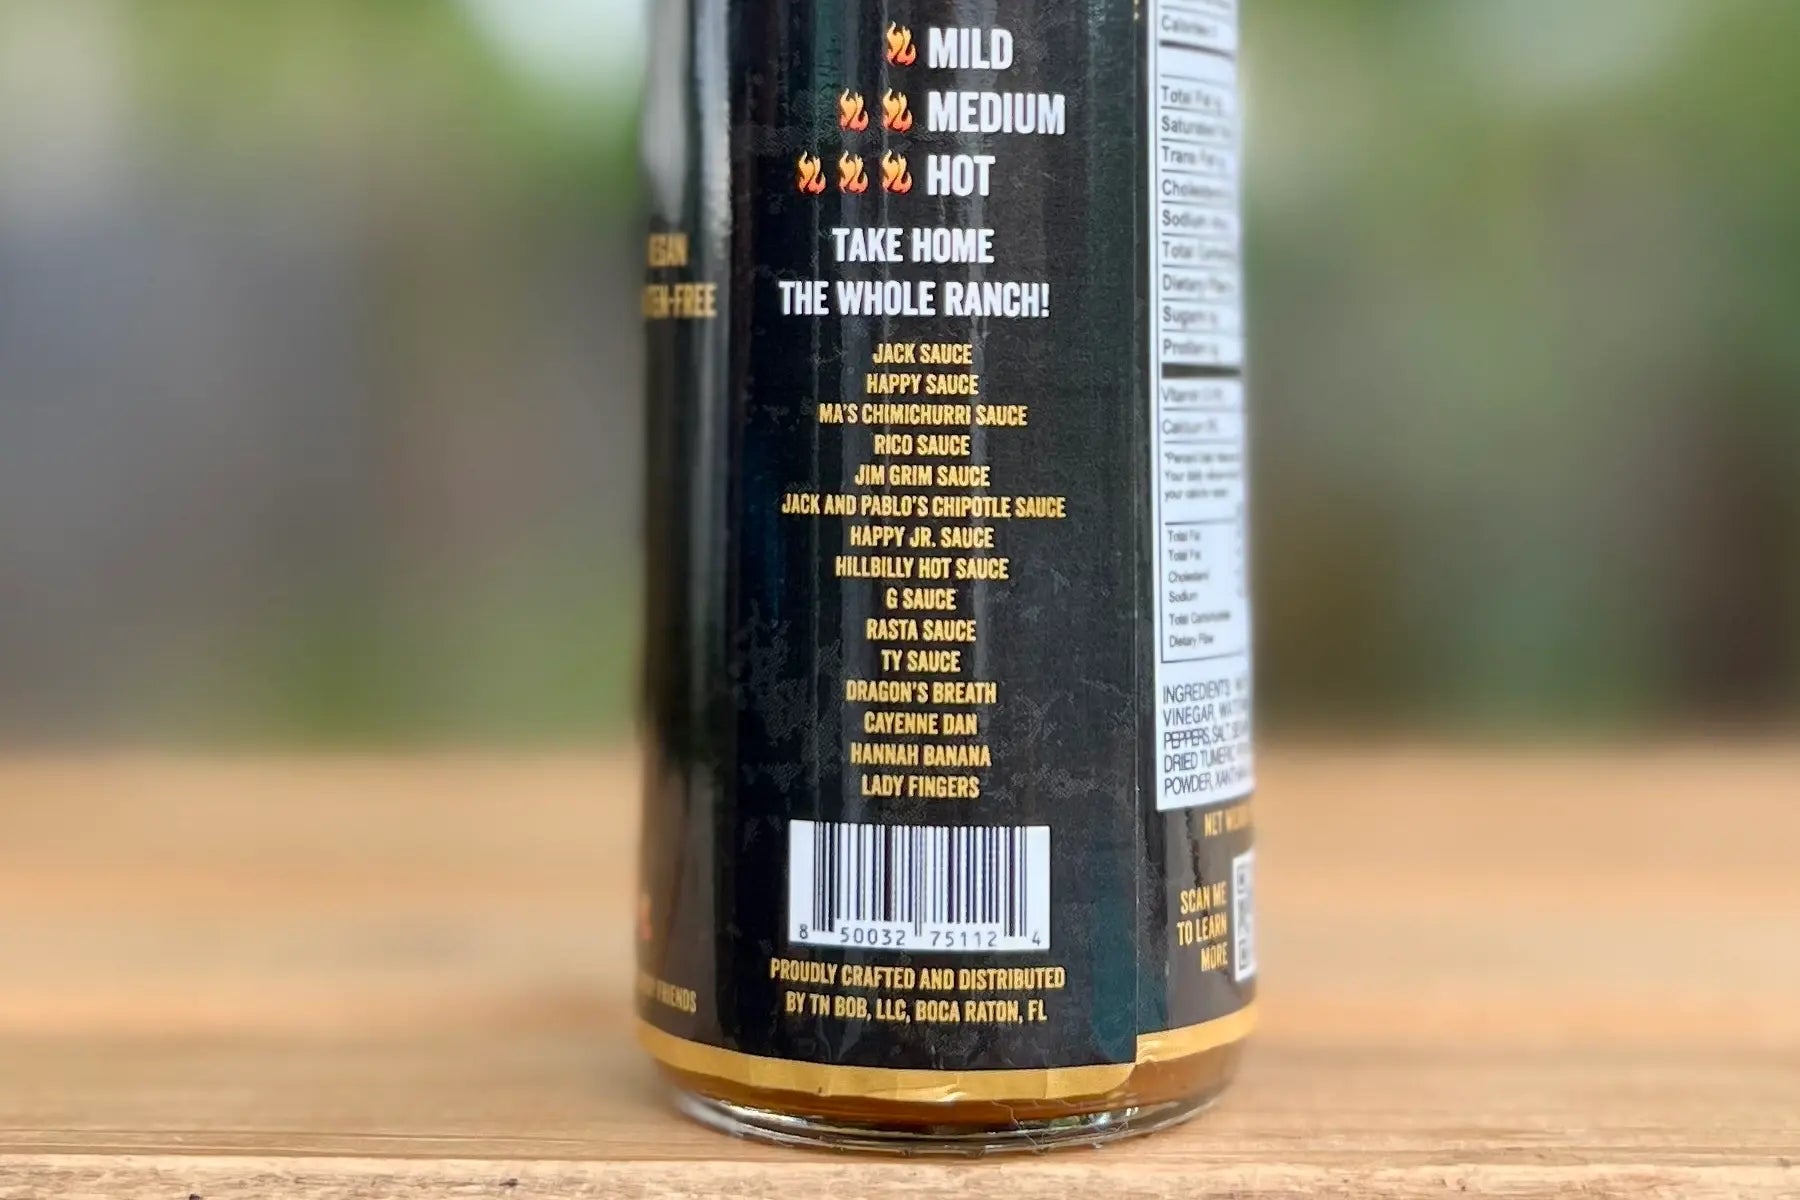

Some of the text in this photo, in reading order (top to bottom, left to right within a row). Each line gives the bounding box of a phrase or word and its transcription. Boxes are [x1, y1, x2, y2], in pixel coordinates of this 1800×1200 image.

[928, 27, 1014, 70] MILD
[927, 90, 1066, 135] MEDIUM
[927, 154, 996, 197] HOT
[831, 227, 995, 264] TAKE HOME
[778, 279, 1050, 318] THE WHOLE RANCH!
[873, 343, 971, 365] JACK SAUCE
[866, 373, 977, 395] HAPPY SAUCE
[819, 403, 1026, 427] MA'S CHIMICHURRI SAUCE
[874, 434, 969, 456] RICO SAUCE
[855, 464, 987, 487] JIM GRIM SAUCE
[782, 494, 1065, 518] JACK AND PABLO'S CHIPOTLE SAUCE
[850, 526, 993, 549] HAPPY JR. SAUCE
[835, 556, 1008, 580] HILLBILLY HOT SAUCE
[886, 588, 955, 611] G SAUCE
[866, 619, 975, 642] RASTA SAUCE
[882, 650, 960, 673] TY SAUCE
[846, 681, 997, 704] DRAGON'S BREATH
[864, 712, 977, 735] CAYENNE DAN
[850, 744, 991, 767] HANNAH BANANA
[1164, 751, 1198, 773] DRIED
[862, 775, 979, 798] LADY FINGERS
[1180, 881, 1227, 914] SCAN ME
[798, 923, 1042, 948] 8 50032 75112 4
[1176, 912, 1228, 946] TO LEARN
[1201, 943, 1229, 971] MORE
[770, 957, 1066, 991] PROUDLY CRAFTED AND DISTRIBUTED
[784, 991, 805, 1016] BY
[834, 995, 872, 1022] BOB,
[876, 998, 912, 1024] LLC,
[915, 999, 961, 1023] BOCA
[965, 1000, 1023, 1025] RATON,
[1028, 998, 1048, 1022] FL
